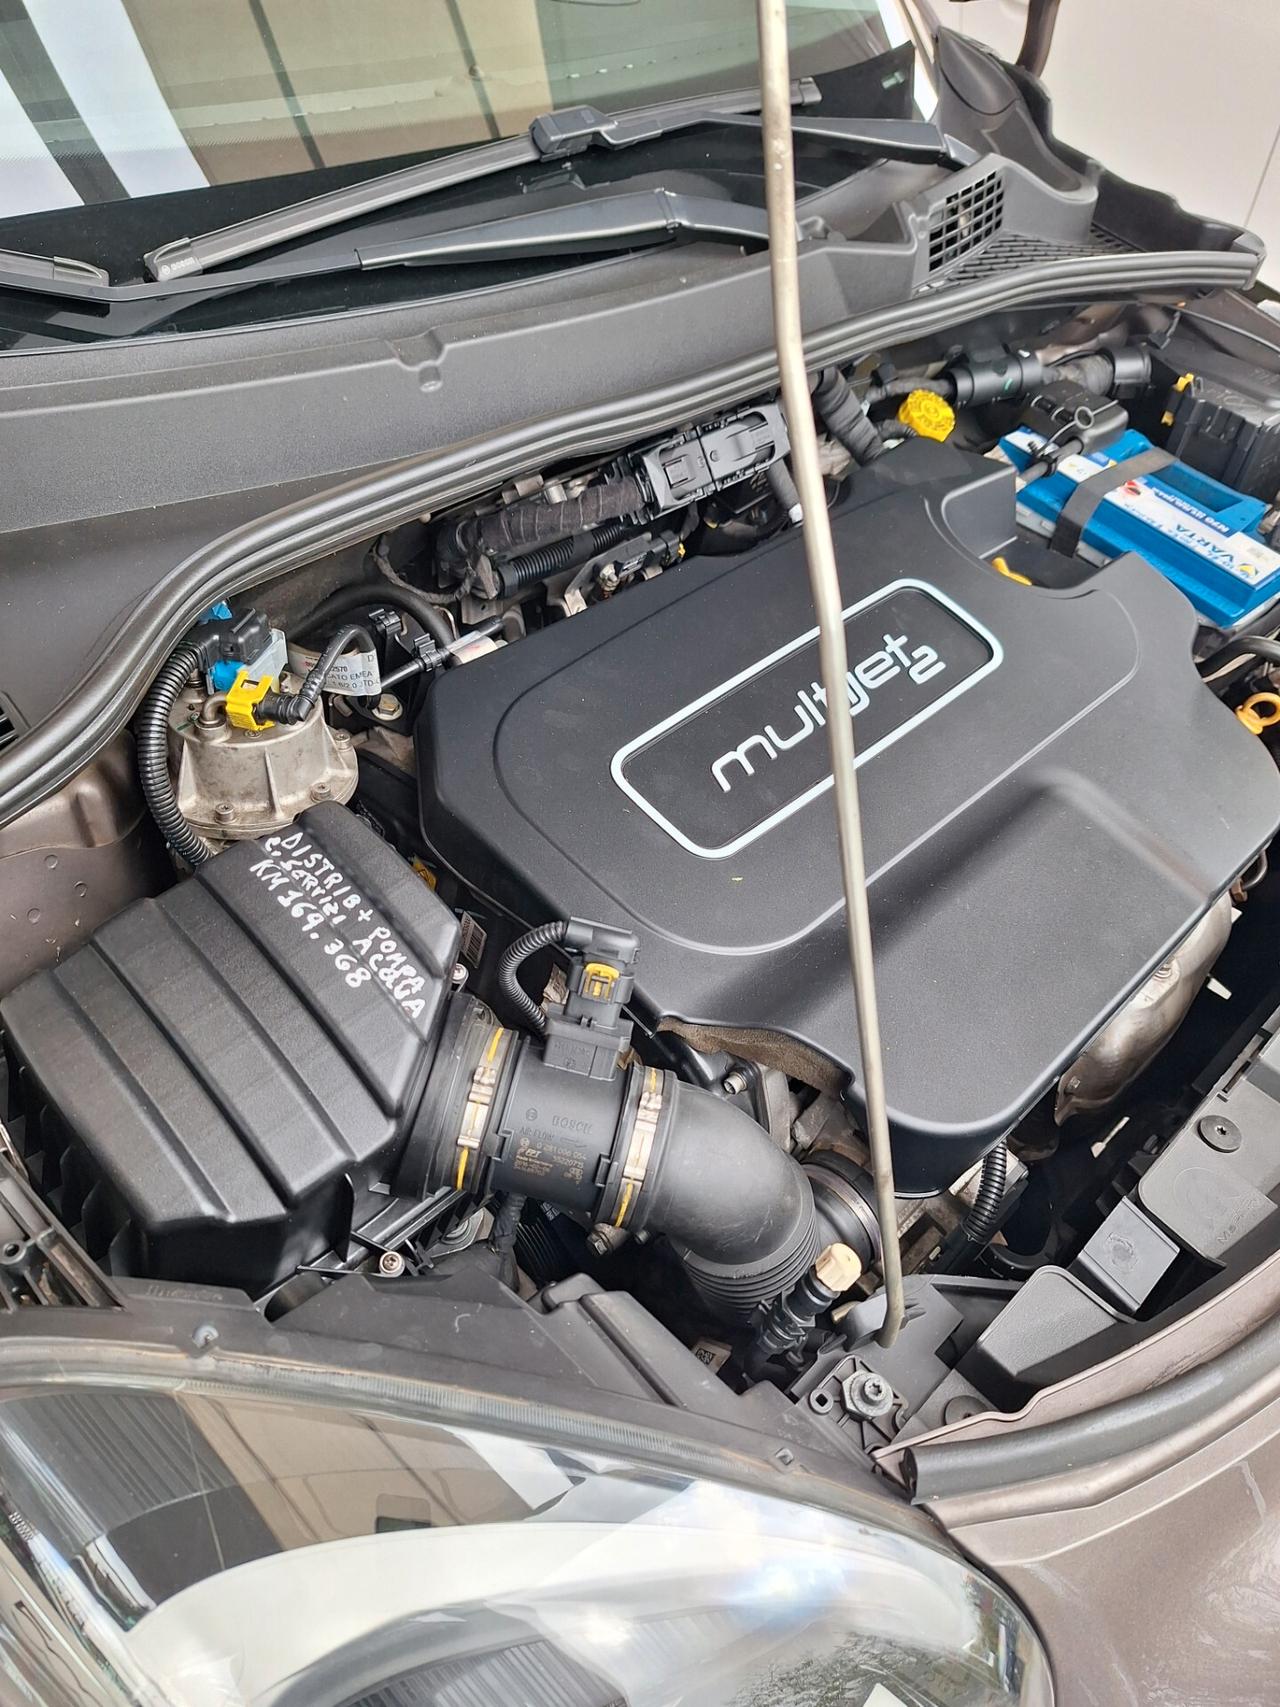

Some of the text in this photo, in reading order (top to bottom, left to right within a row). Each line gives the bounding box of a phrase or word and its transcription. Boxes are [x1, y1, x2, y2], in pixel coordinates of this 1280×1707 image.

[1176, 523, 1234, 562] VARTA
[250, 859, 289, 891] KM
[280, 859, 346, 924] SERVIZI
[353, 938, 426, 1019] ACQUA
[368, 926, 426, 994] POMPA
[552, 1115, 593, 1134] BOSCH
